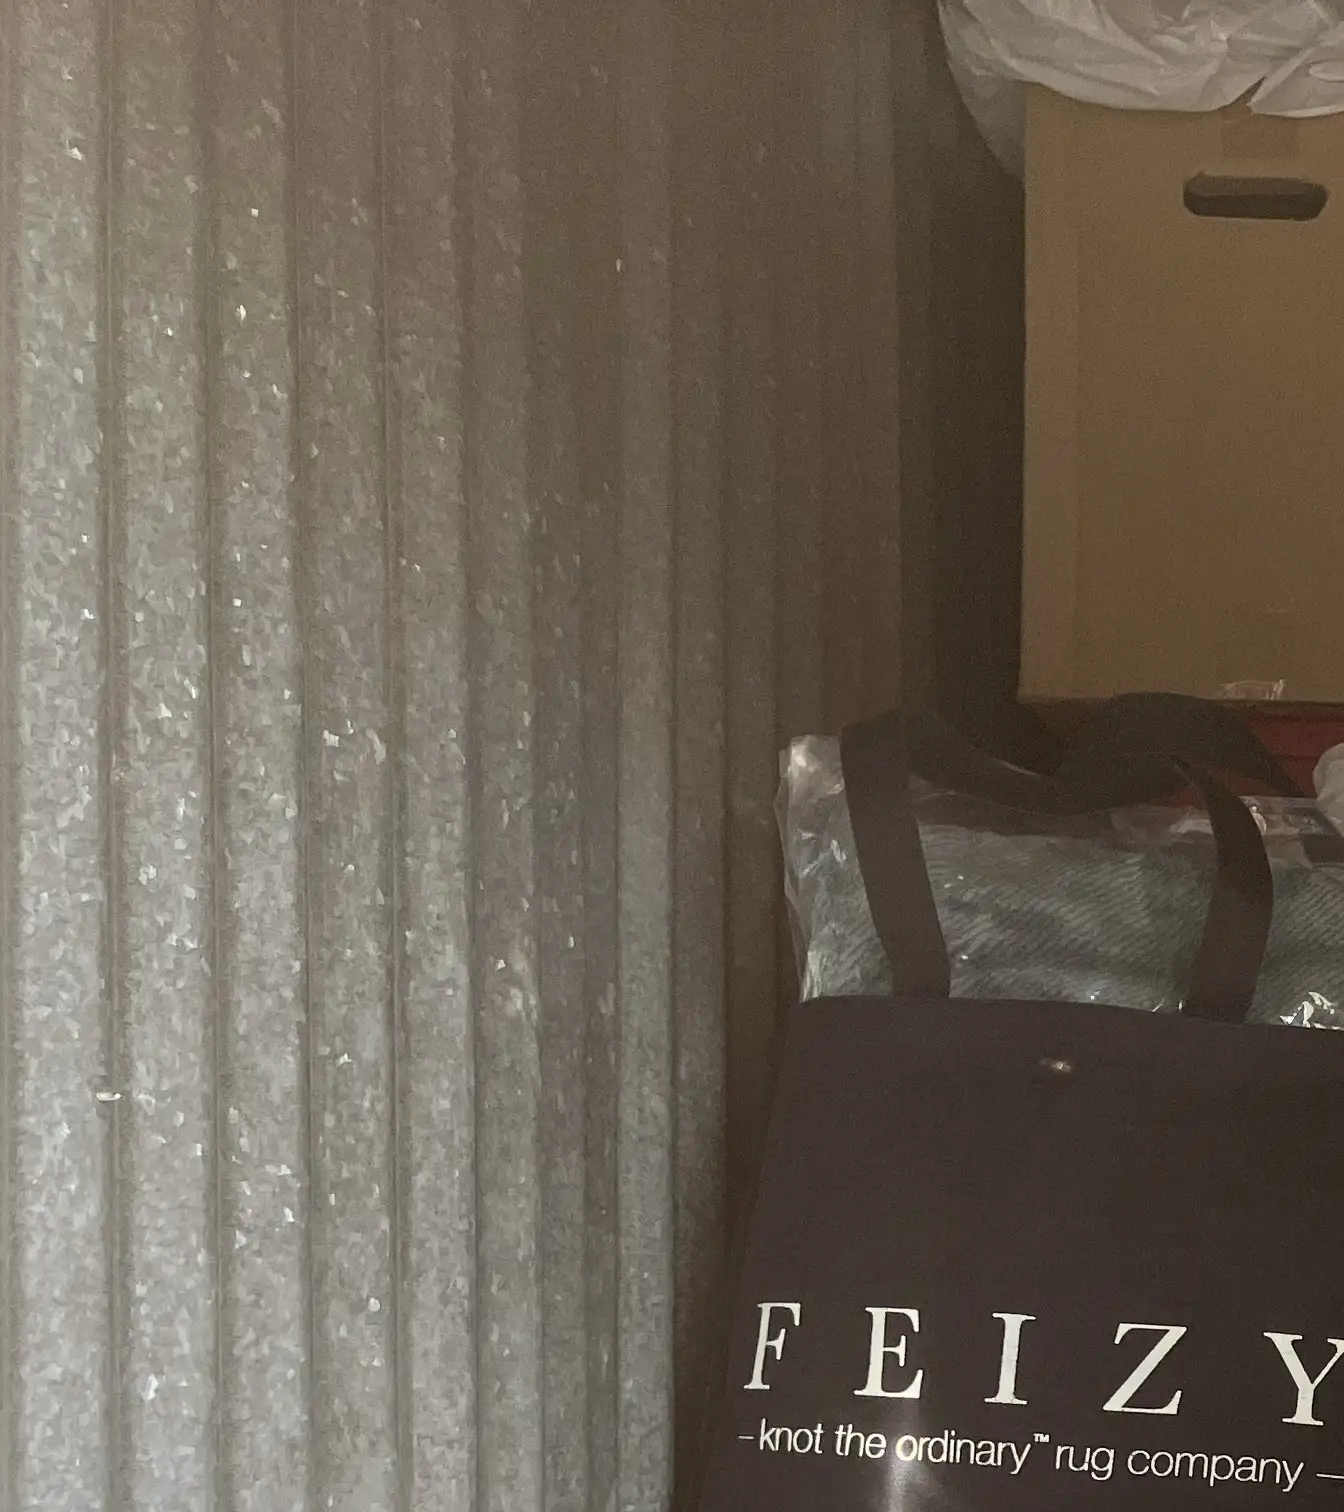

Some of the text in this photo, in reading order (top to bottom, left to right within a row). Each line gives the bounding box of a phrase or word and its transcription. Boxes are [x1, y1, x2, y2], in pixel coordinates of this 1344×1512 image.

[834, 1423, 888, 1459] the
[1054, 1443, 1116, 1481] rug
[1126, 1449, 1306, 1493] company
